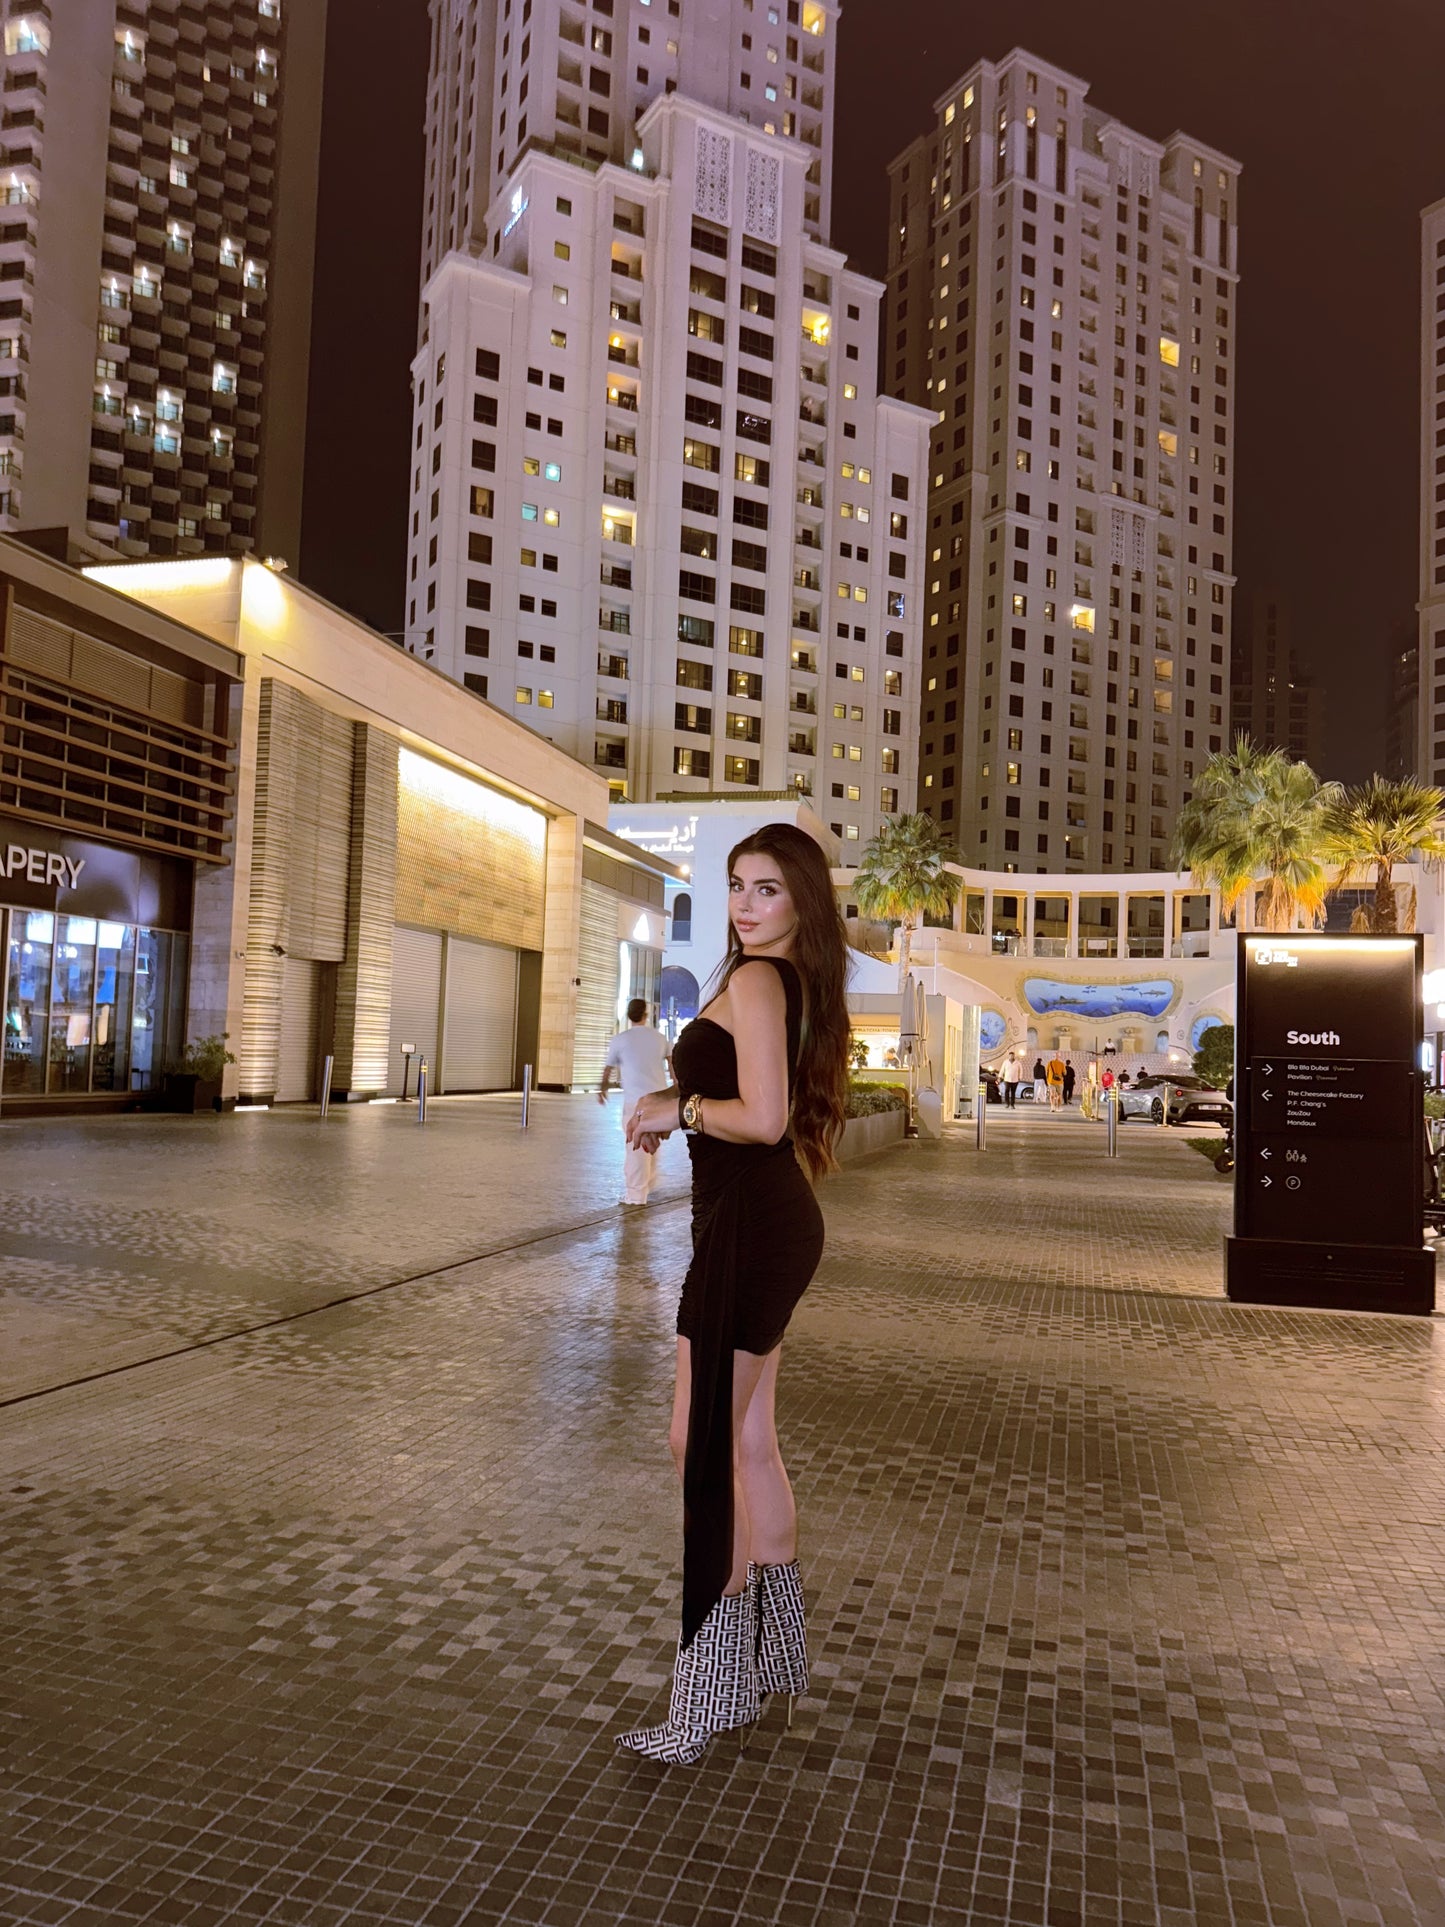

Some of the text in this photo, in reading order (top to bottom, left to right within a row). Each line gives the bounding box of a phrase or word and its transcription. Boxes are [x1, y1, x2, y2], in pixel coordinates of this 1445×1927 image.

[0, 844, 86, 890] PERY
[1287, 1031, 1340, 1045] South
[1339, 1092, 1364, 1100] Factory
